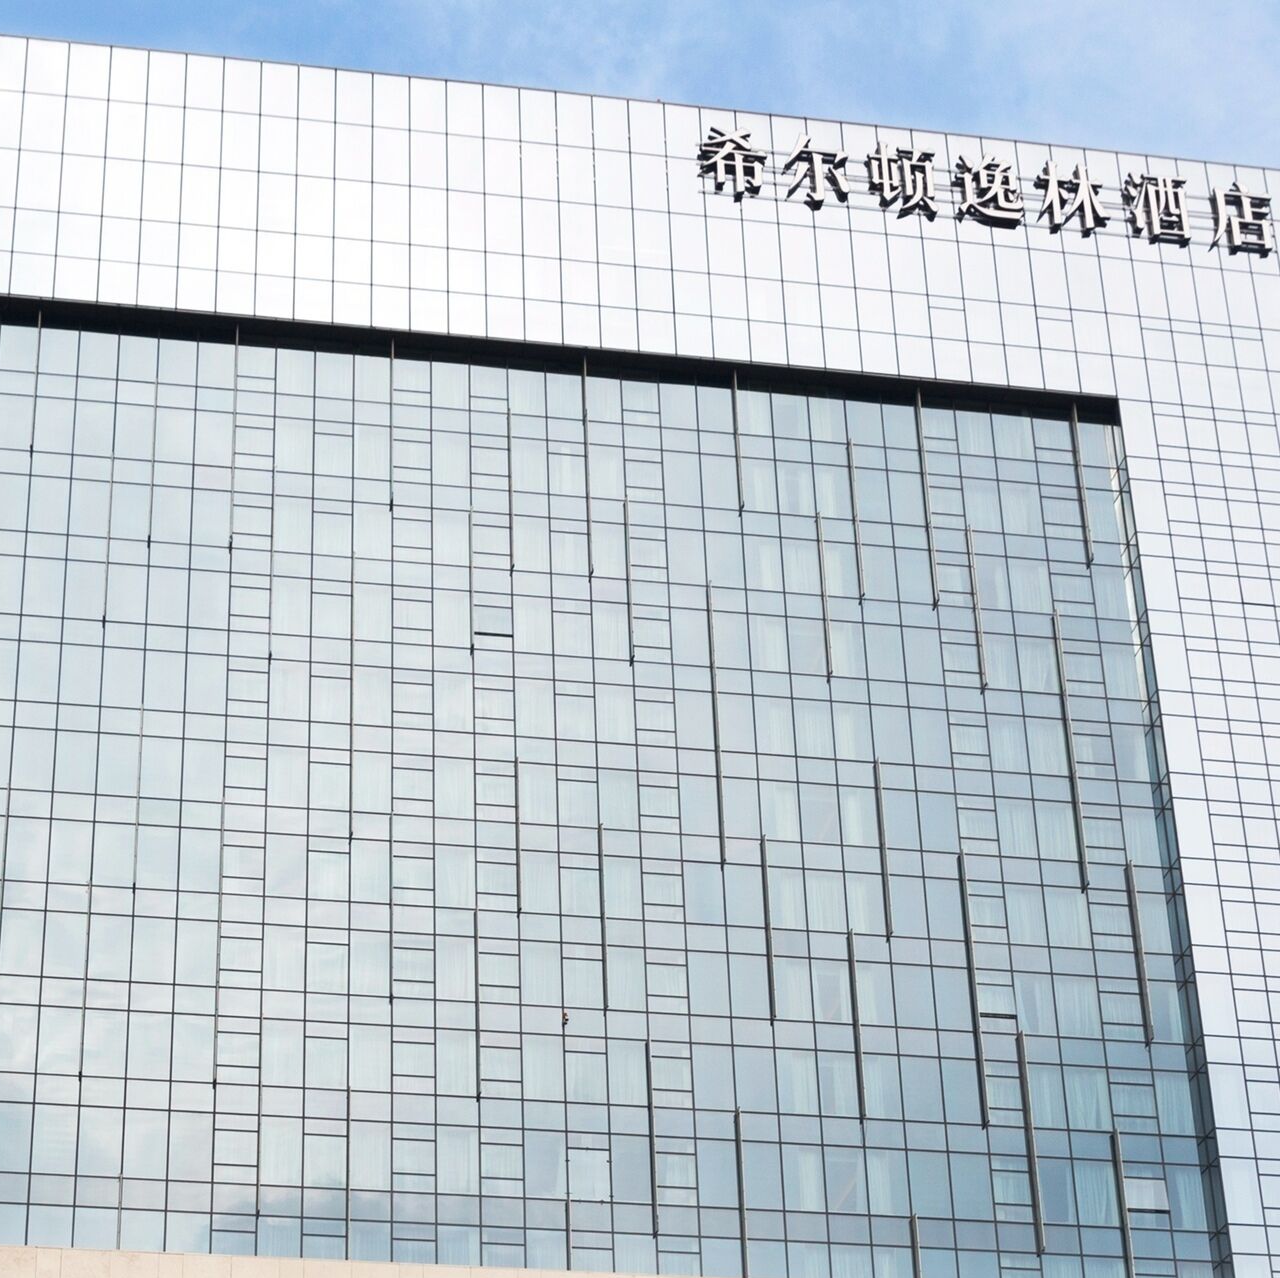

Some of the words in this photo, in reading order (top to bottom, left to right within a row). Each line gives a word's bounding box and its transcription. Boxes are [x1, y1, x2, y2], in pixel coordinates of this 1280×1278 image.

[698, 126, 1273, 258] 希尔顿逸林酒店
